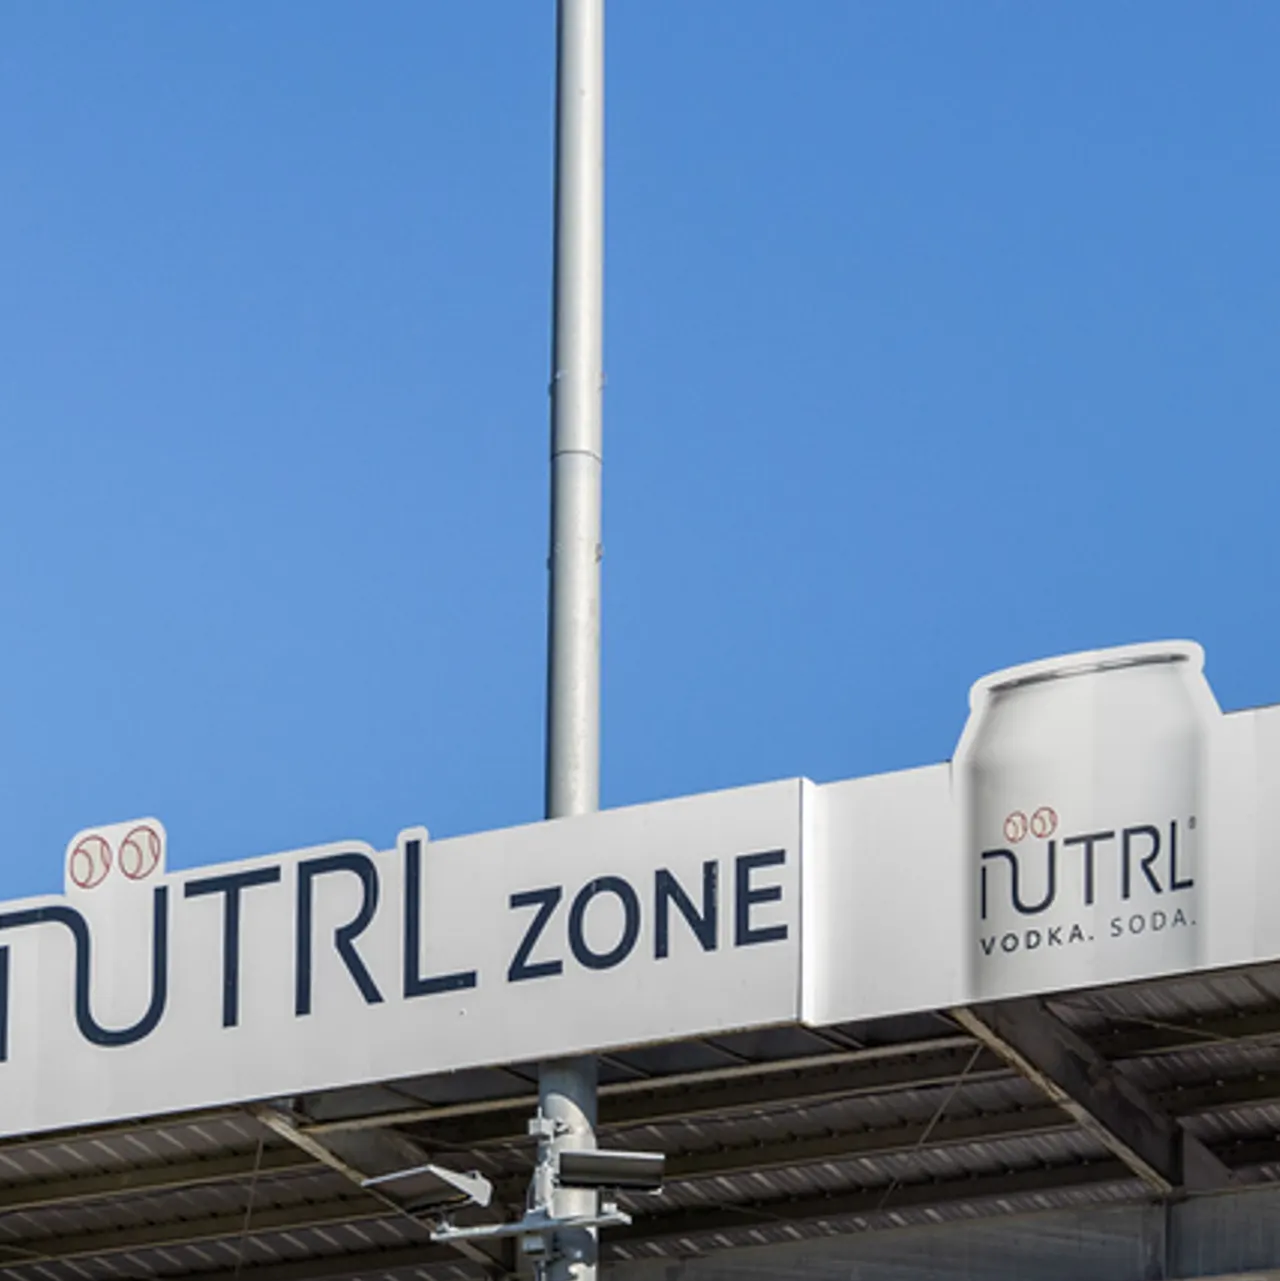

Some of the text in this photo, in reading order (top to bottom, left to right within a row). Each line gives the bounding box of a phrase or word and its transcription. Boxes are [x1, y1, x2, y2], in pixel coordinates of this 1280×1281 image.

[505, 848, 790, 983] ZONE
[979, 908, 1198, 956] VODKA. SODA.
